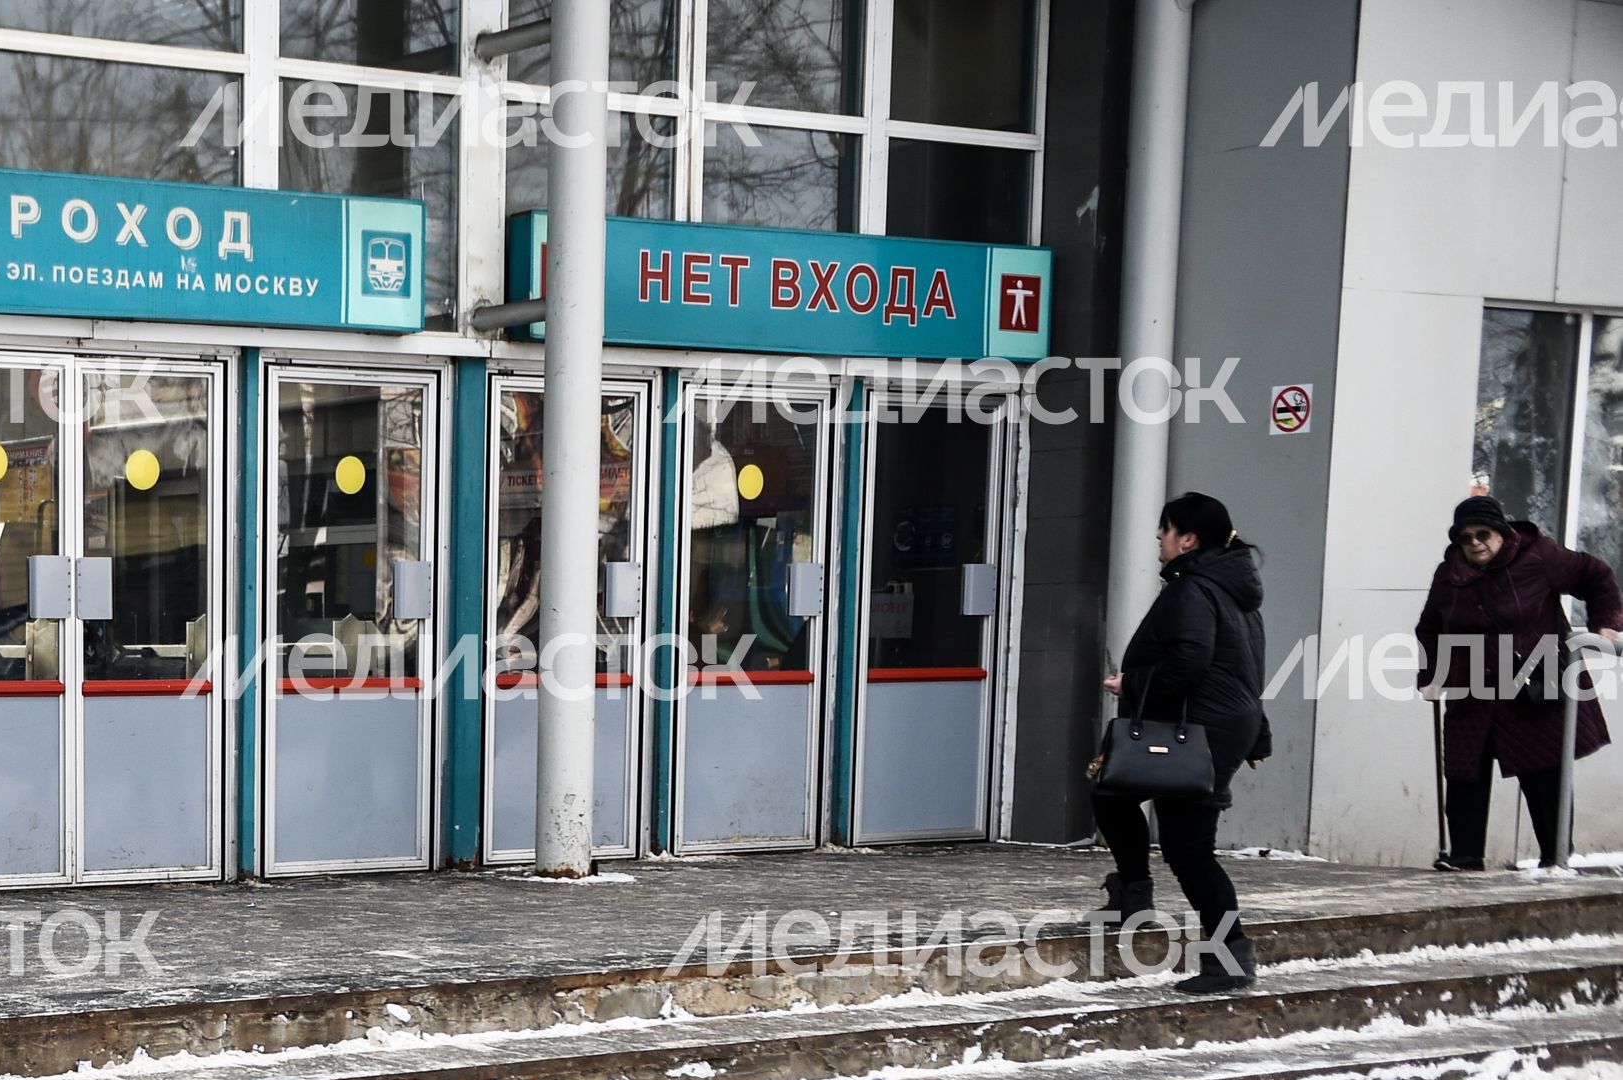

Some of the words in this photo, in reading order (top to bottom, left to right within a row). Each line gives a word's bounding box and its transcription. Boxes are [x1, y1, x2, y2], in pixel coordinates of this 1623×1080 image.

[6, 263, 45, 282] ЭЛ.
[53, 265, 164, 290] ПОЕЗДАМ
[177, 273, 205, 292] НА
[214, 273, 320, 298] МОСКВУ
[638, 248, 751, 308] НЕТ
[770, 257, 957, 327] ВХОДА
